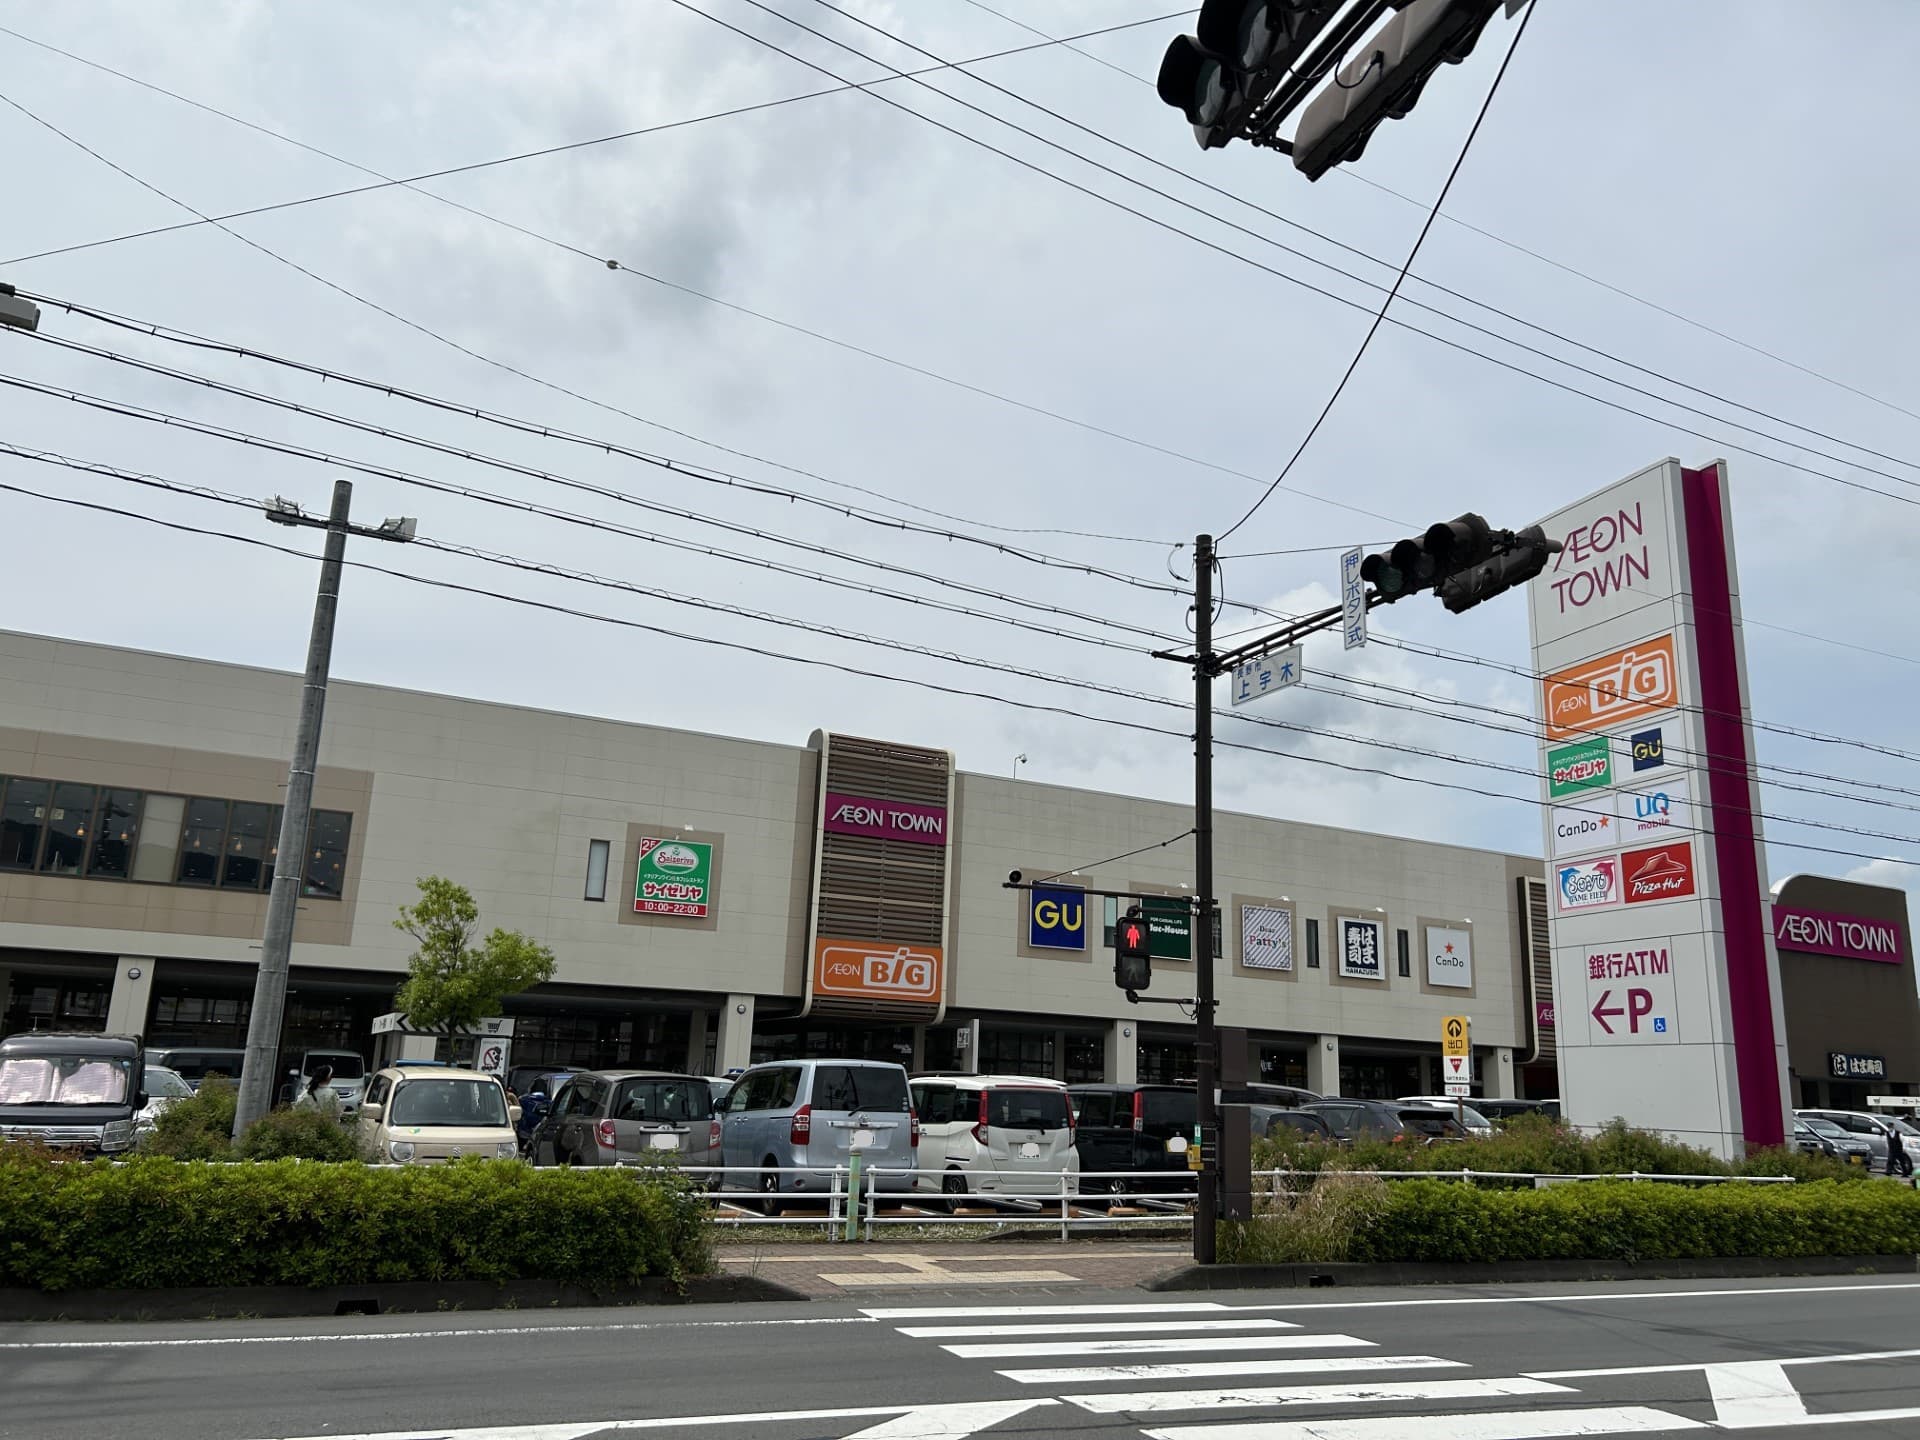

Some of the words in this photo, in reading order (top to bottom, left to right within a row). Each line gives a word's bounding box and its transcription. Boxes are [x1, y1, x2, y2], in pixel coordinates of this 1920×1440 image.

[1551, 546, 1649, 613] TOWN
[1345, 553, 1362, 645] 押しボタン式
[1238, 661, 1294, 699] 上宇木
[1633, 739, 1662, 760] GU
[1553, 758, 1607, 786] サイゼリヤ
[1635, 792, 1670, 818] UQ
[888, 811, 942, 834] TOWN
[1558, 820, 1597, 838] CanDo
[1637, 818, 1670, 831] mobile
[642, 840, 656, 851] 2F
[643, 881, 703, 901] サイゼリヤ
[1632, 881, 1661, 897] Pizza
[1663, 877, 1686, 890] Hut
[1034, 900, 1081, 931] GU
[1249, 936, 1287, 948] Patty's
[1837, 922, 1896, 954] TOWN
[1435, 955, 1464, 968] CanDo
[1588, 949, 1669, 980] 銀行ATM
[1628, 988, 1653, 1033] P
[1448, 1039, 1463, 1049] 出口
